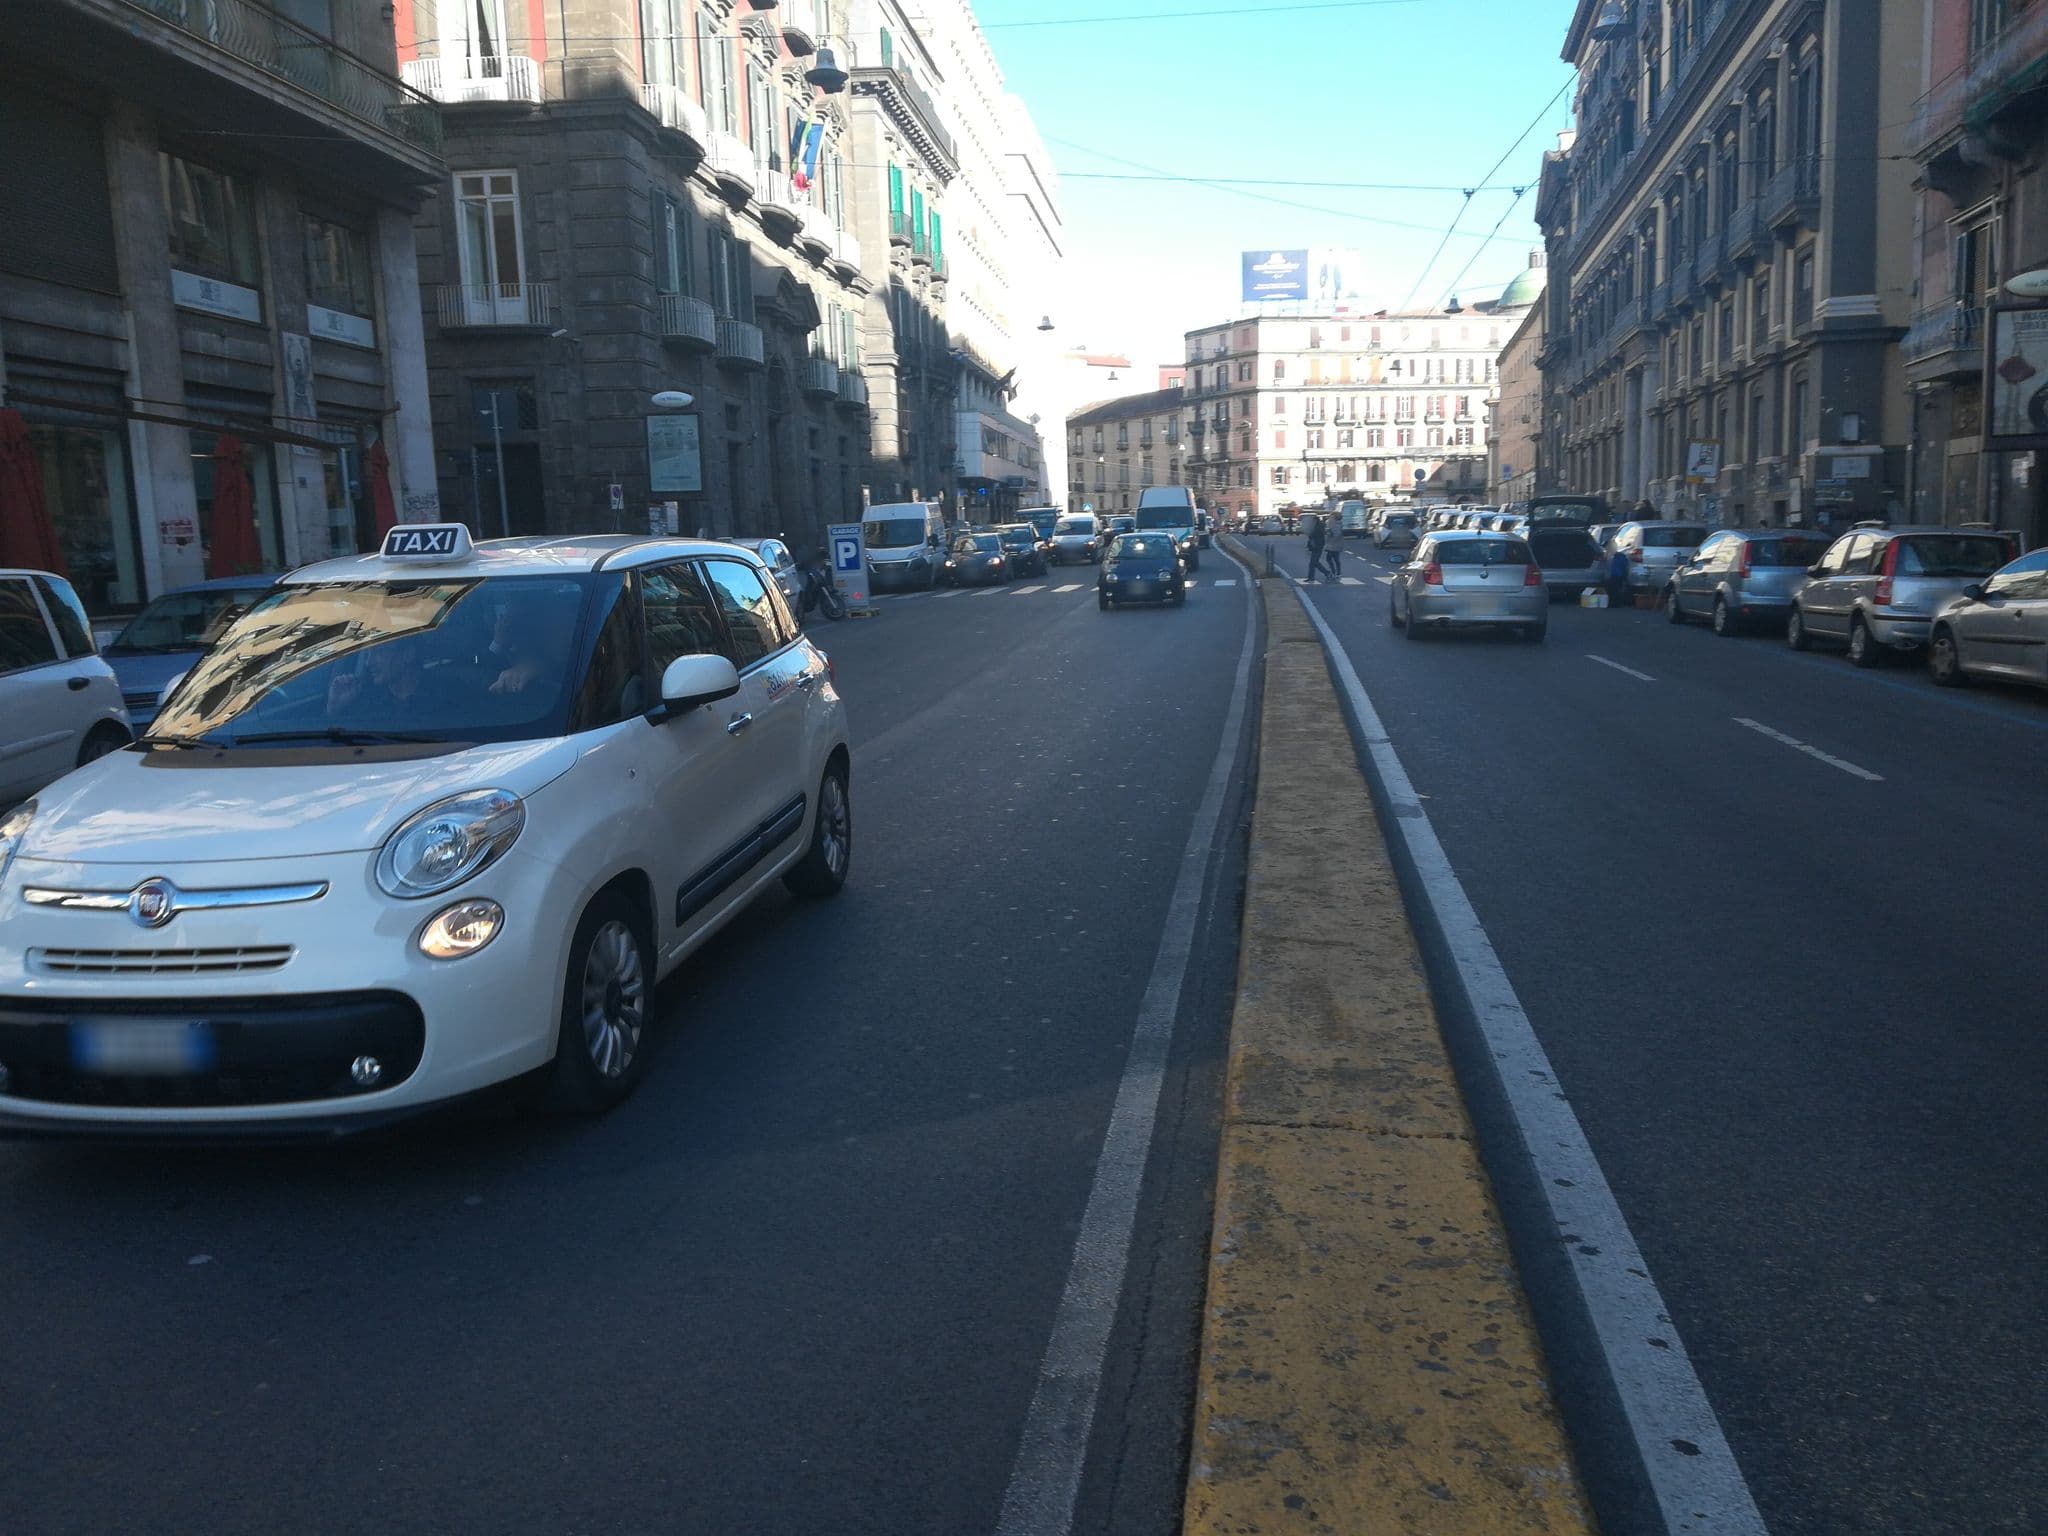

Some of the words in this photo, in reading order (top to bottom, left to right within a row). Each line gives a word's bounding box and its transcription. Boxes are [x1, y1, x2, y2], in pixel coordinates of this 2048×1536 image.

[391, 531, 452, 552] TAXI
[831, 527, 860, 535] GARAGE
[837, 541, 857, 568] P
